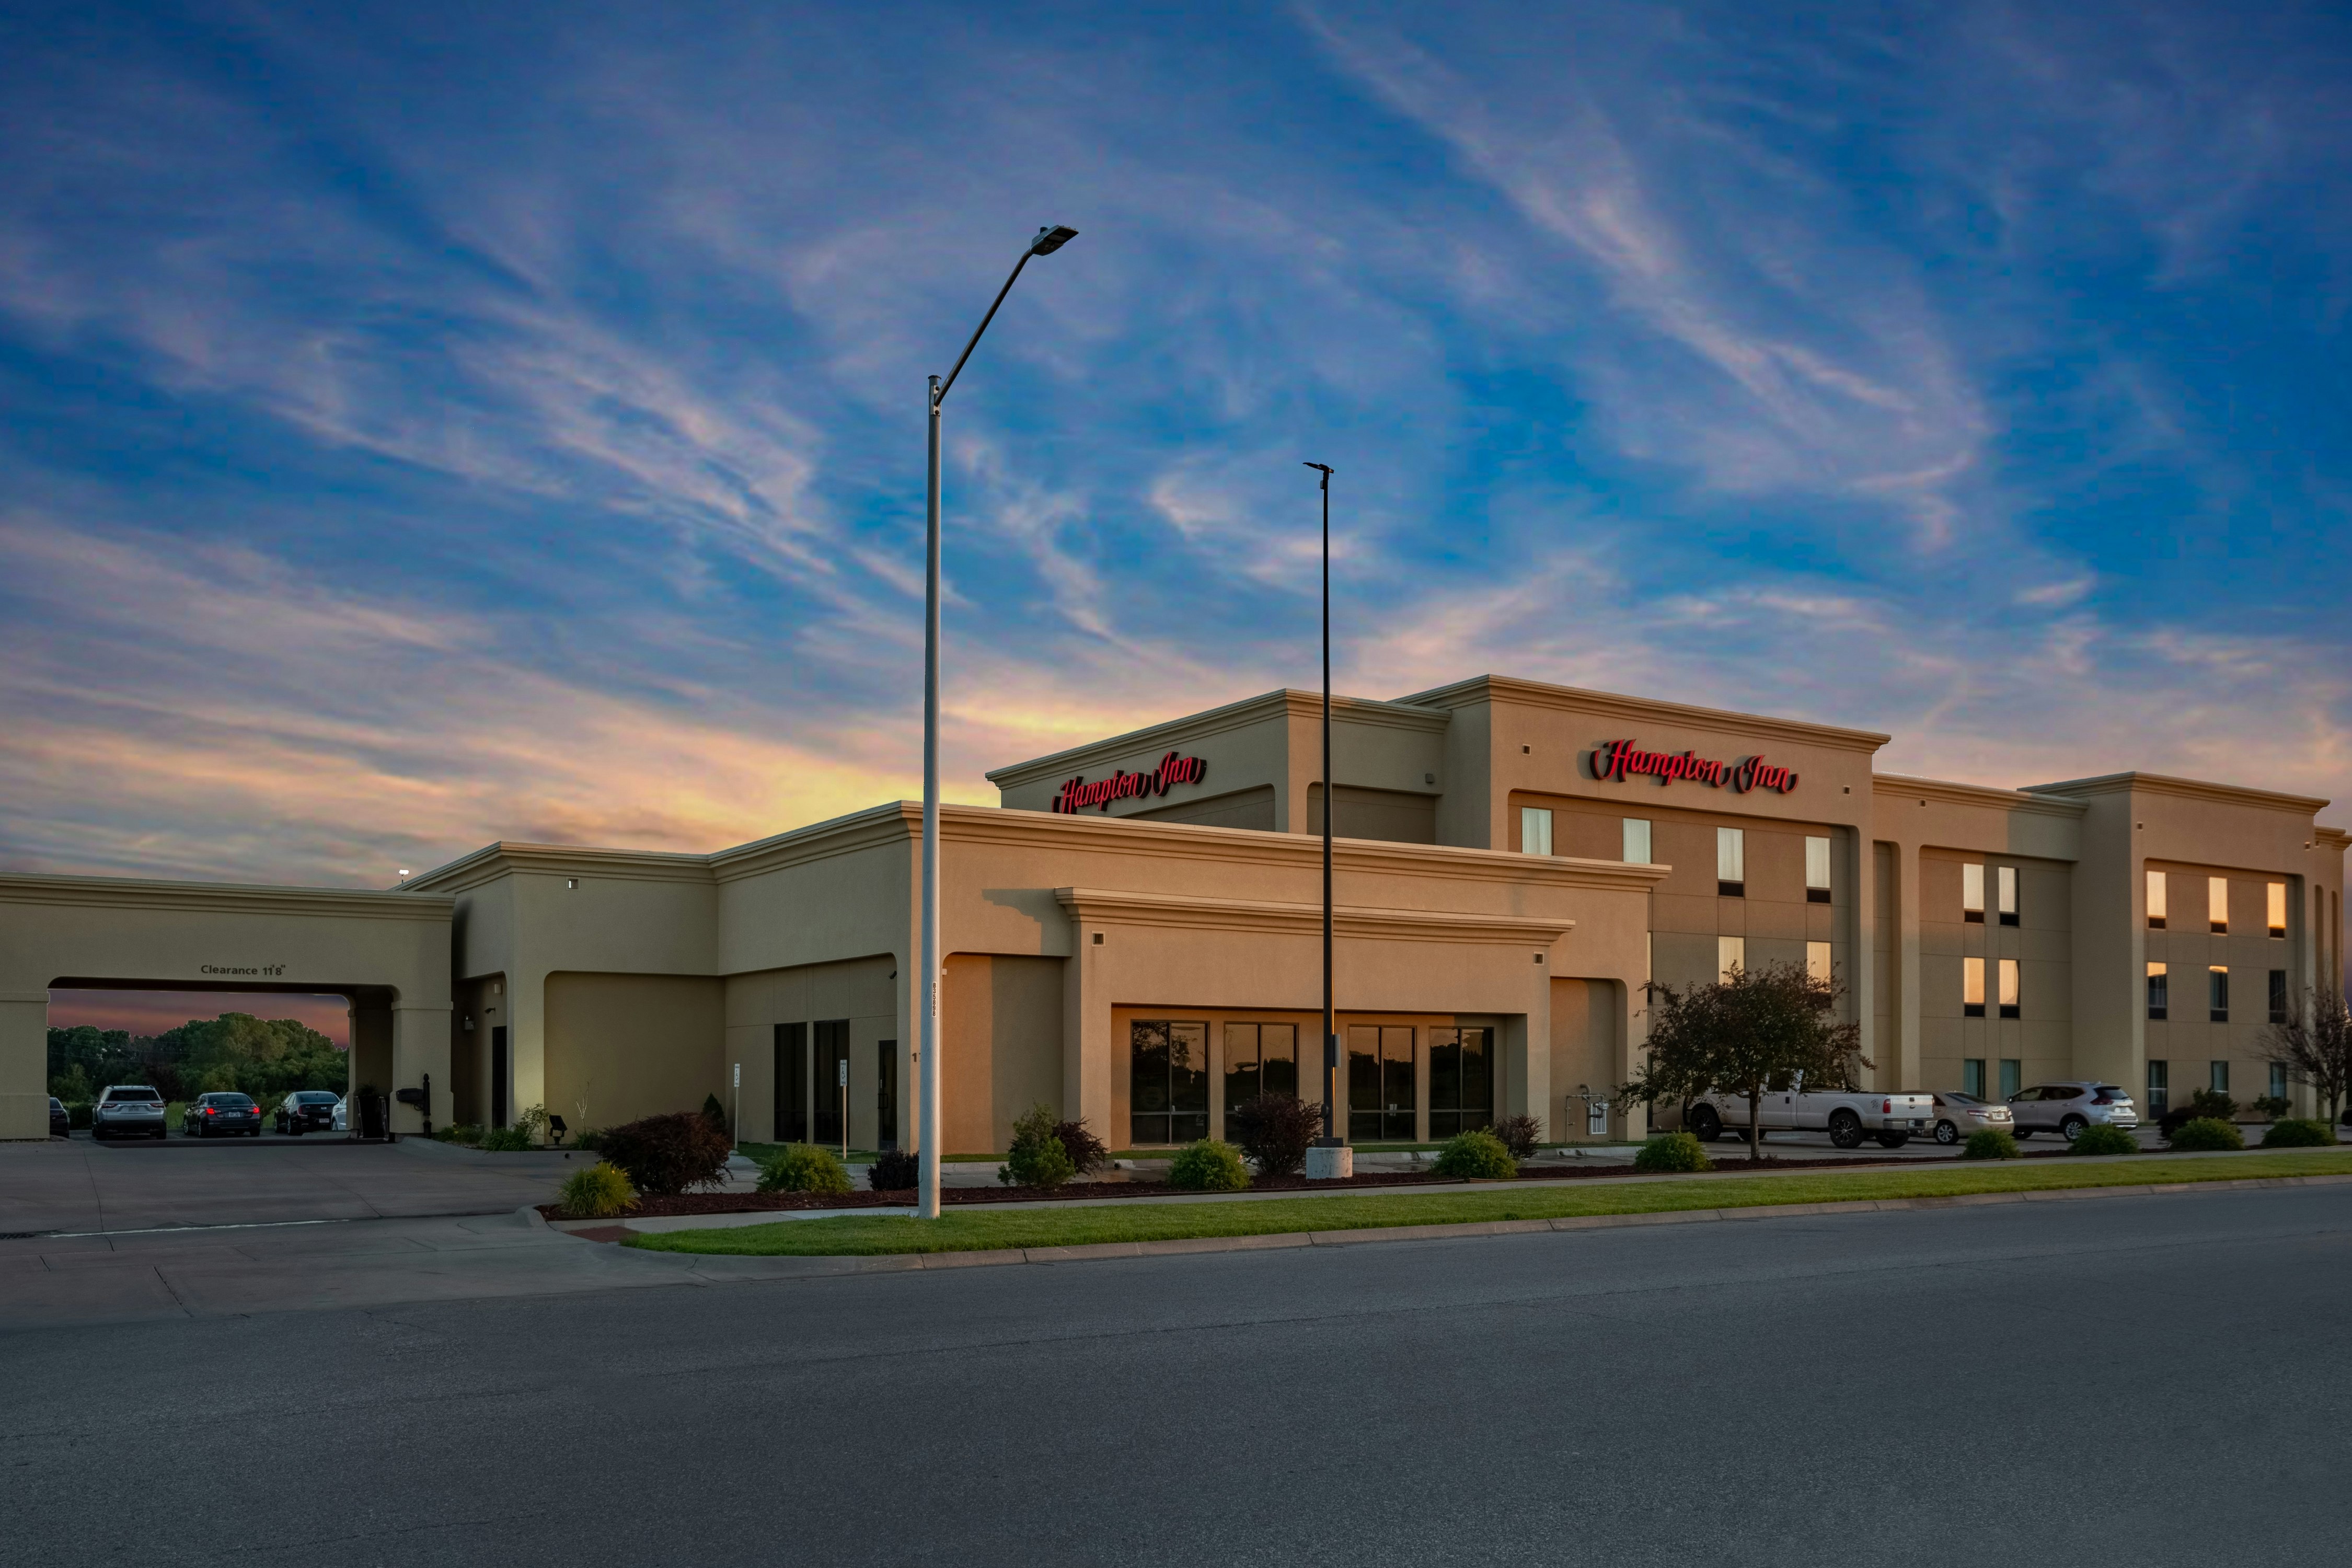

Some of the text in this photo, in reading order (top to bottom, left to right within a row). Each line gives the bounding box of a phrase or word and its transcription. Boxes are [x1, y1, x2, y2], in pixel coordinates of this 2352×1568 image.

[1052, 752, 1205, 814] Hampton Inn
[1590, 739, 1799, 793] Hampton Inn
[201, 965, 258, 975] Clearance
